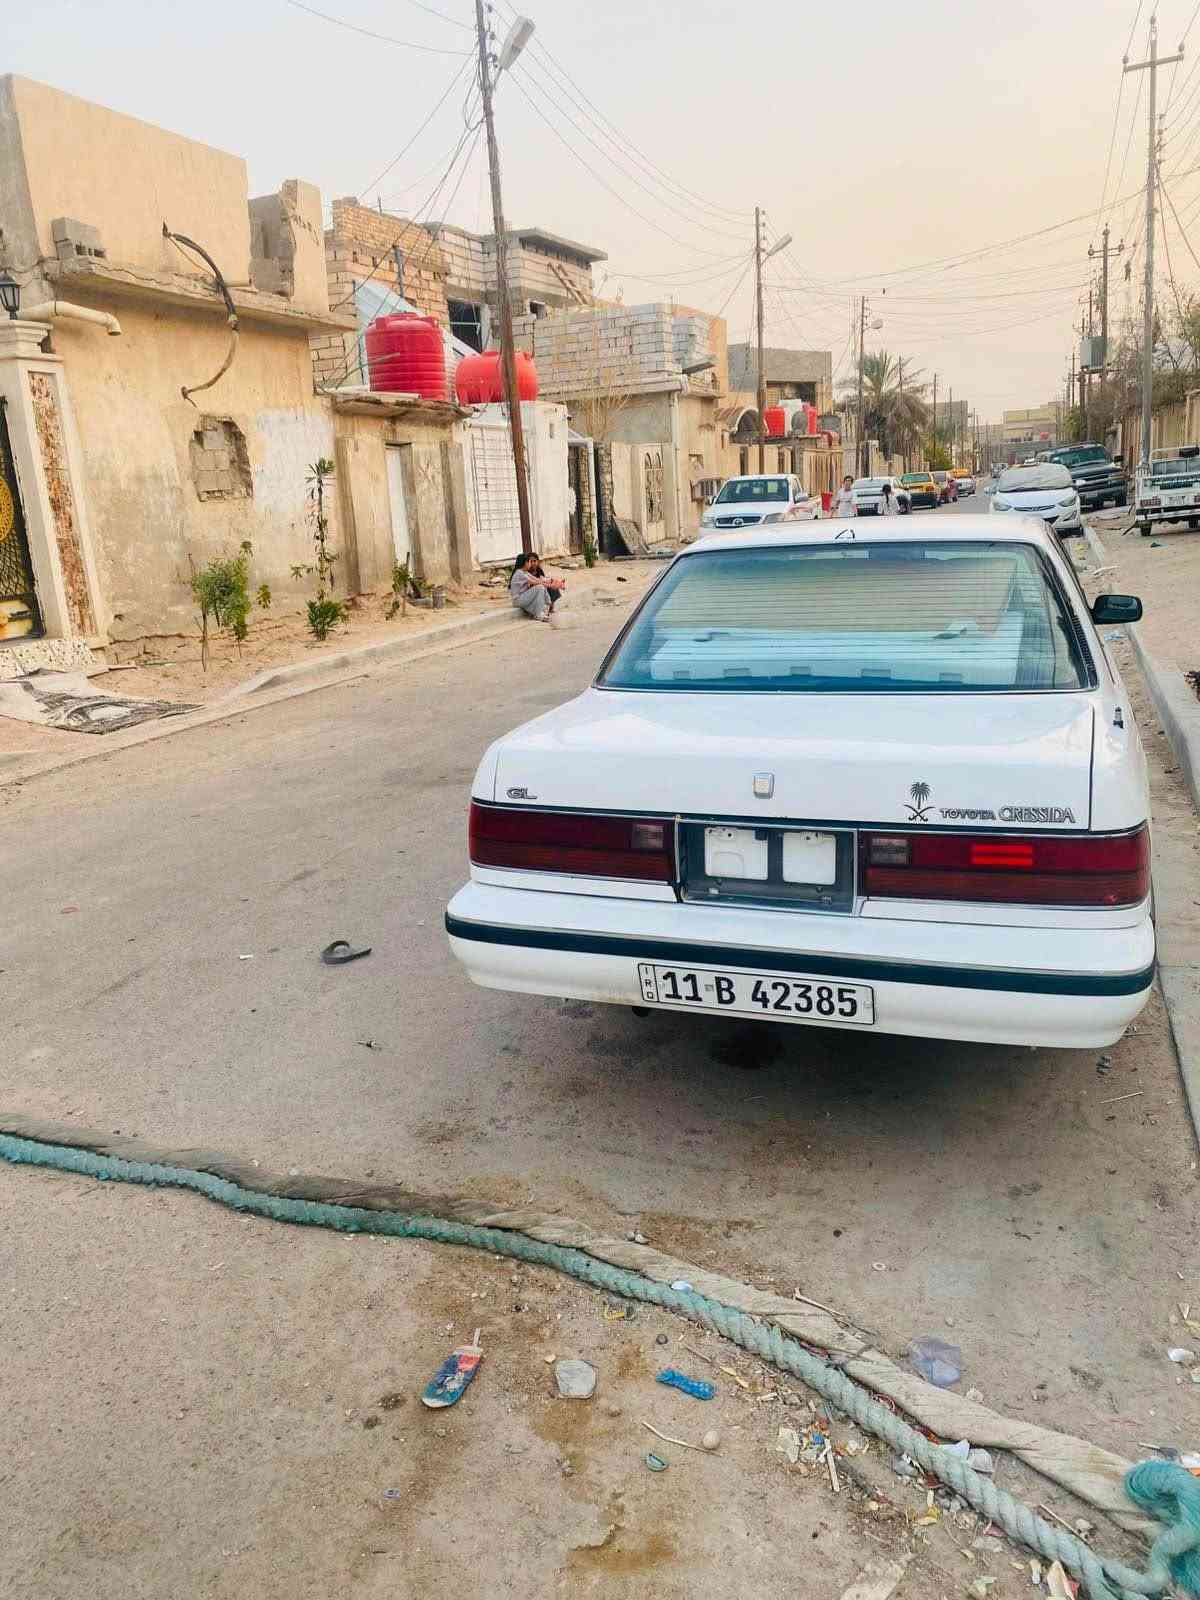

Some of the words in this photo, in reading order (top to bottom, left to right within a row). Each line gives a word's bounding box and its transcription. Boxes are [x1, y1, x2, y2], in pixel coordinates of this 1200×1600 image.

[506, 787, 538, 800] GL
[939, 807, 996, 821] TOYOTA
[998, 806, 1076, 823] CRESSIDA
[662, 971, 703, 1002] 11
[714, 976, 736, 1005] B
[751, 980, 858, 1017] 42385
